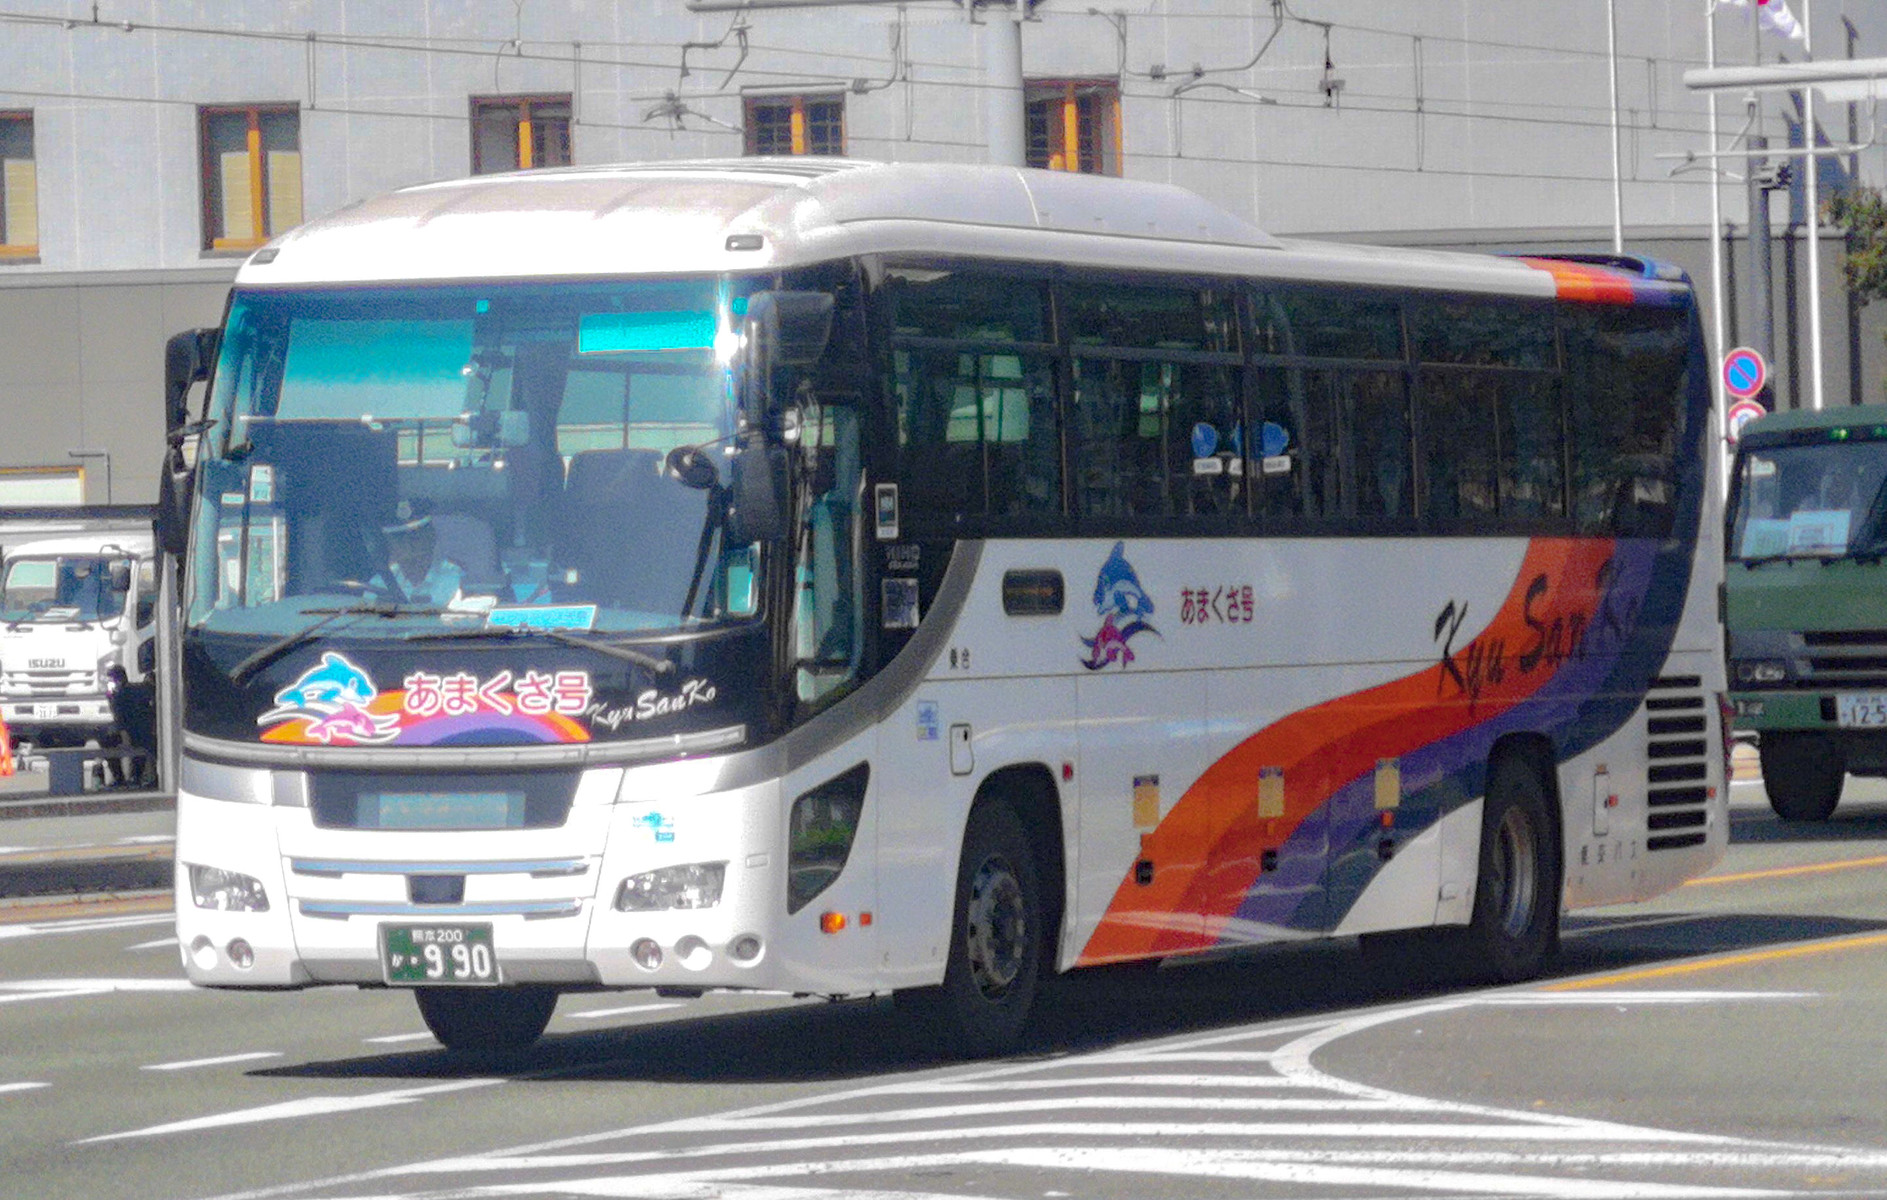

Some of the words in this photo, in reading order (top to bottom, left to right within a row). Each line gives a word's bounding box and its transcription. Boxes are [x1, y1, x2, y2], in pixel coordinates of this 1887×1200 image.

[1181, 586, 1254, 624] あまくさ号
[28, 658, 65, 669] ISUZU
[402, 670, 592, 716] あまくさ号
